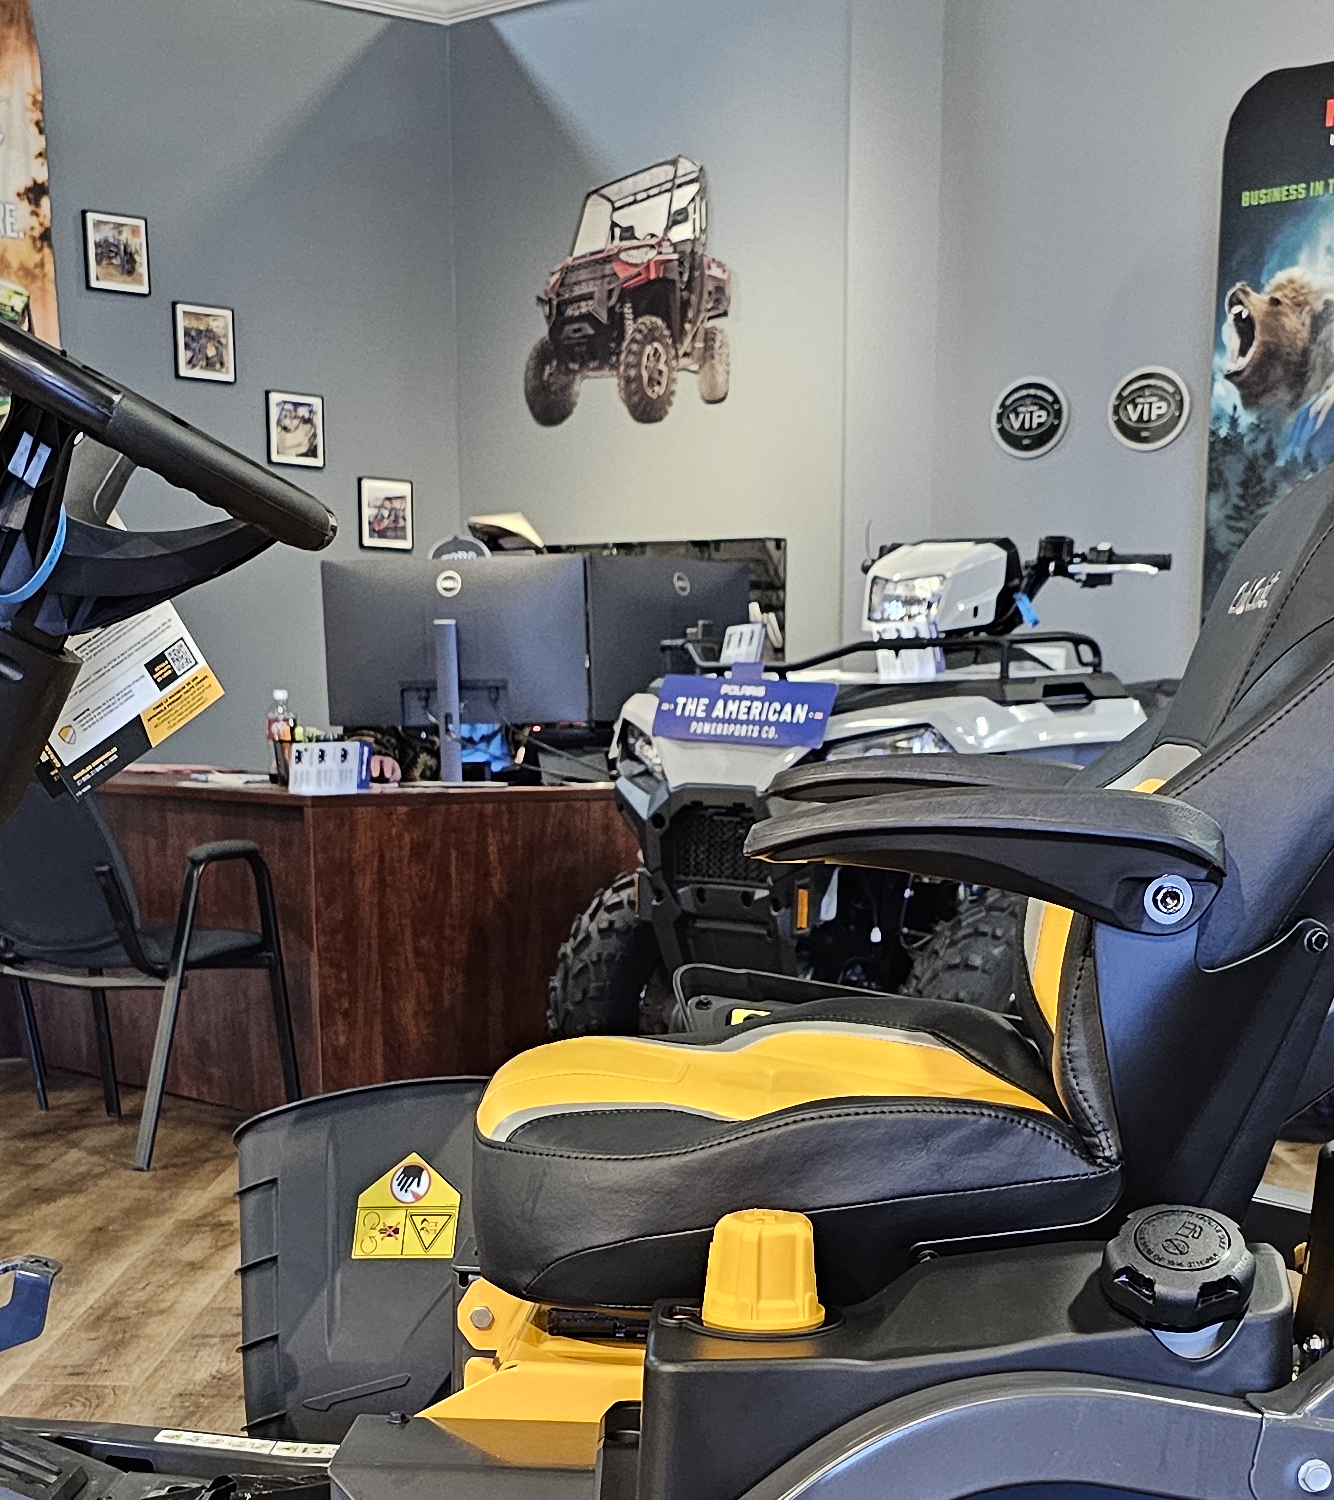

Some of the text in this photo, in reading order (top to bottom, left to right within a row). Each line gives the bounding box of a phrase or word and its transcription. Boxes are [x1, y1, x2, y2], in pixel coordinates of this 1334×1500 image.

[1241, 182, 1307, 207] BUSINESS
[1310, 179, 1324, 197] IN
[1008, 409, 1049, 430] VIP
[1126, 401, 1168, 422] VIP
[675, 696, 809, 724] THE AMERICAN
[689, 720, 761, 739] POWERSPORTS
